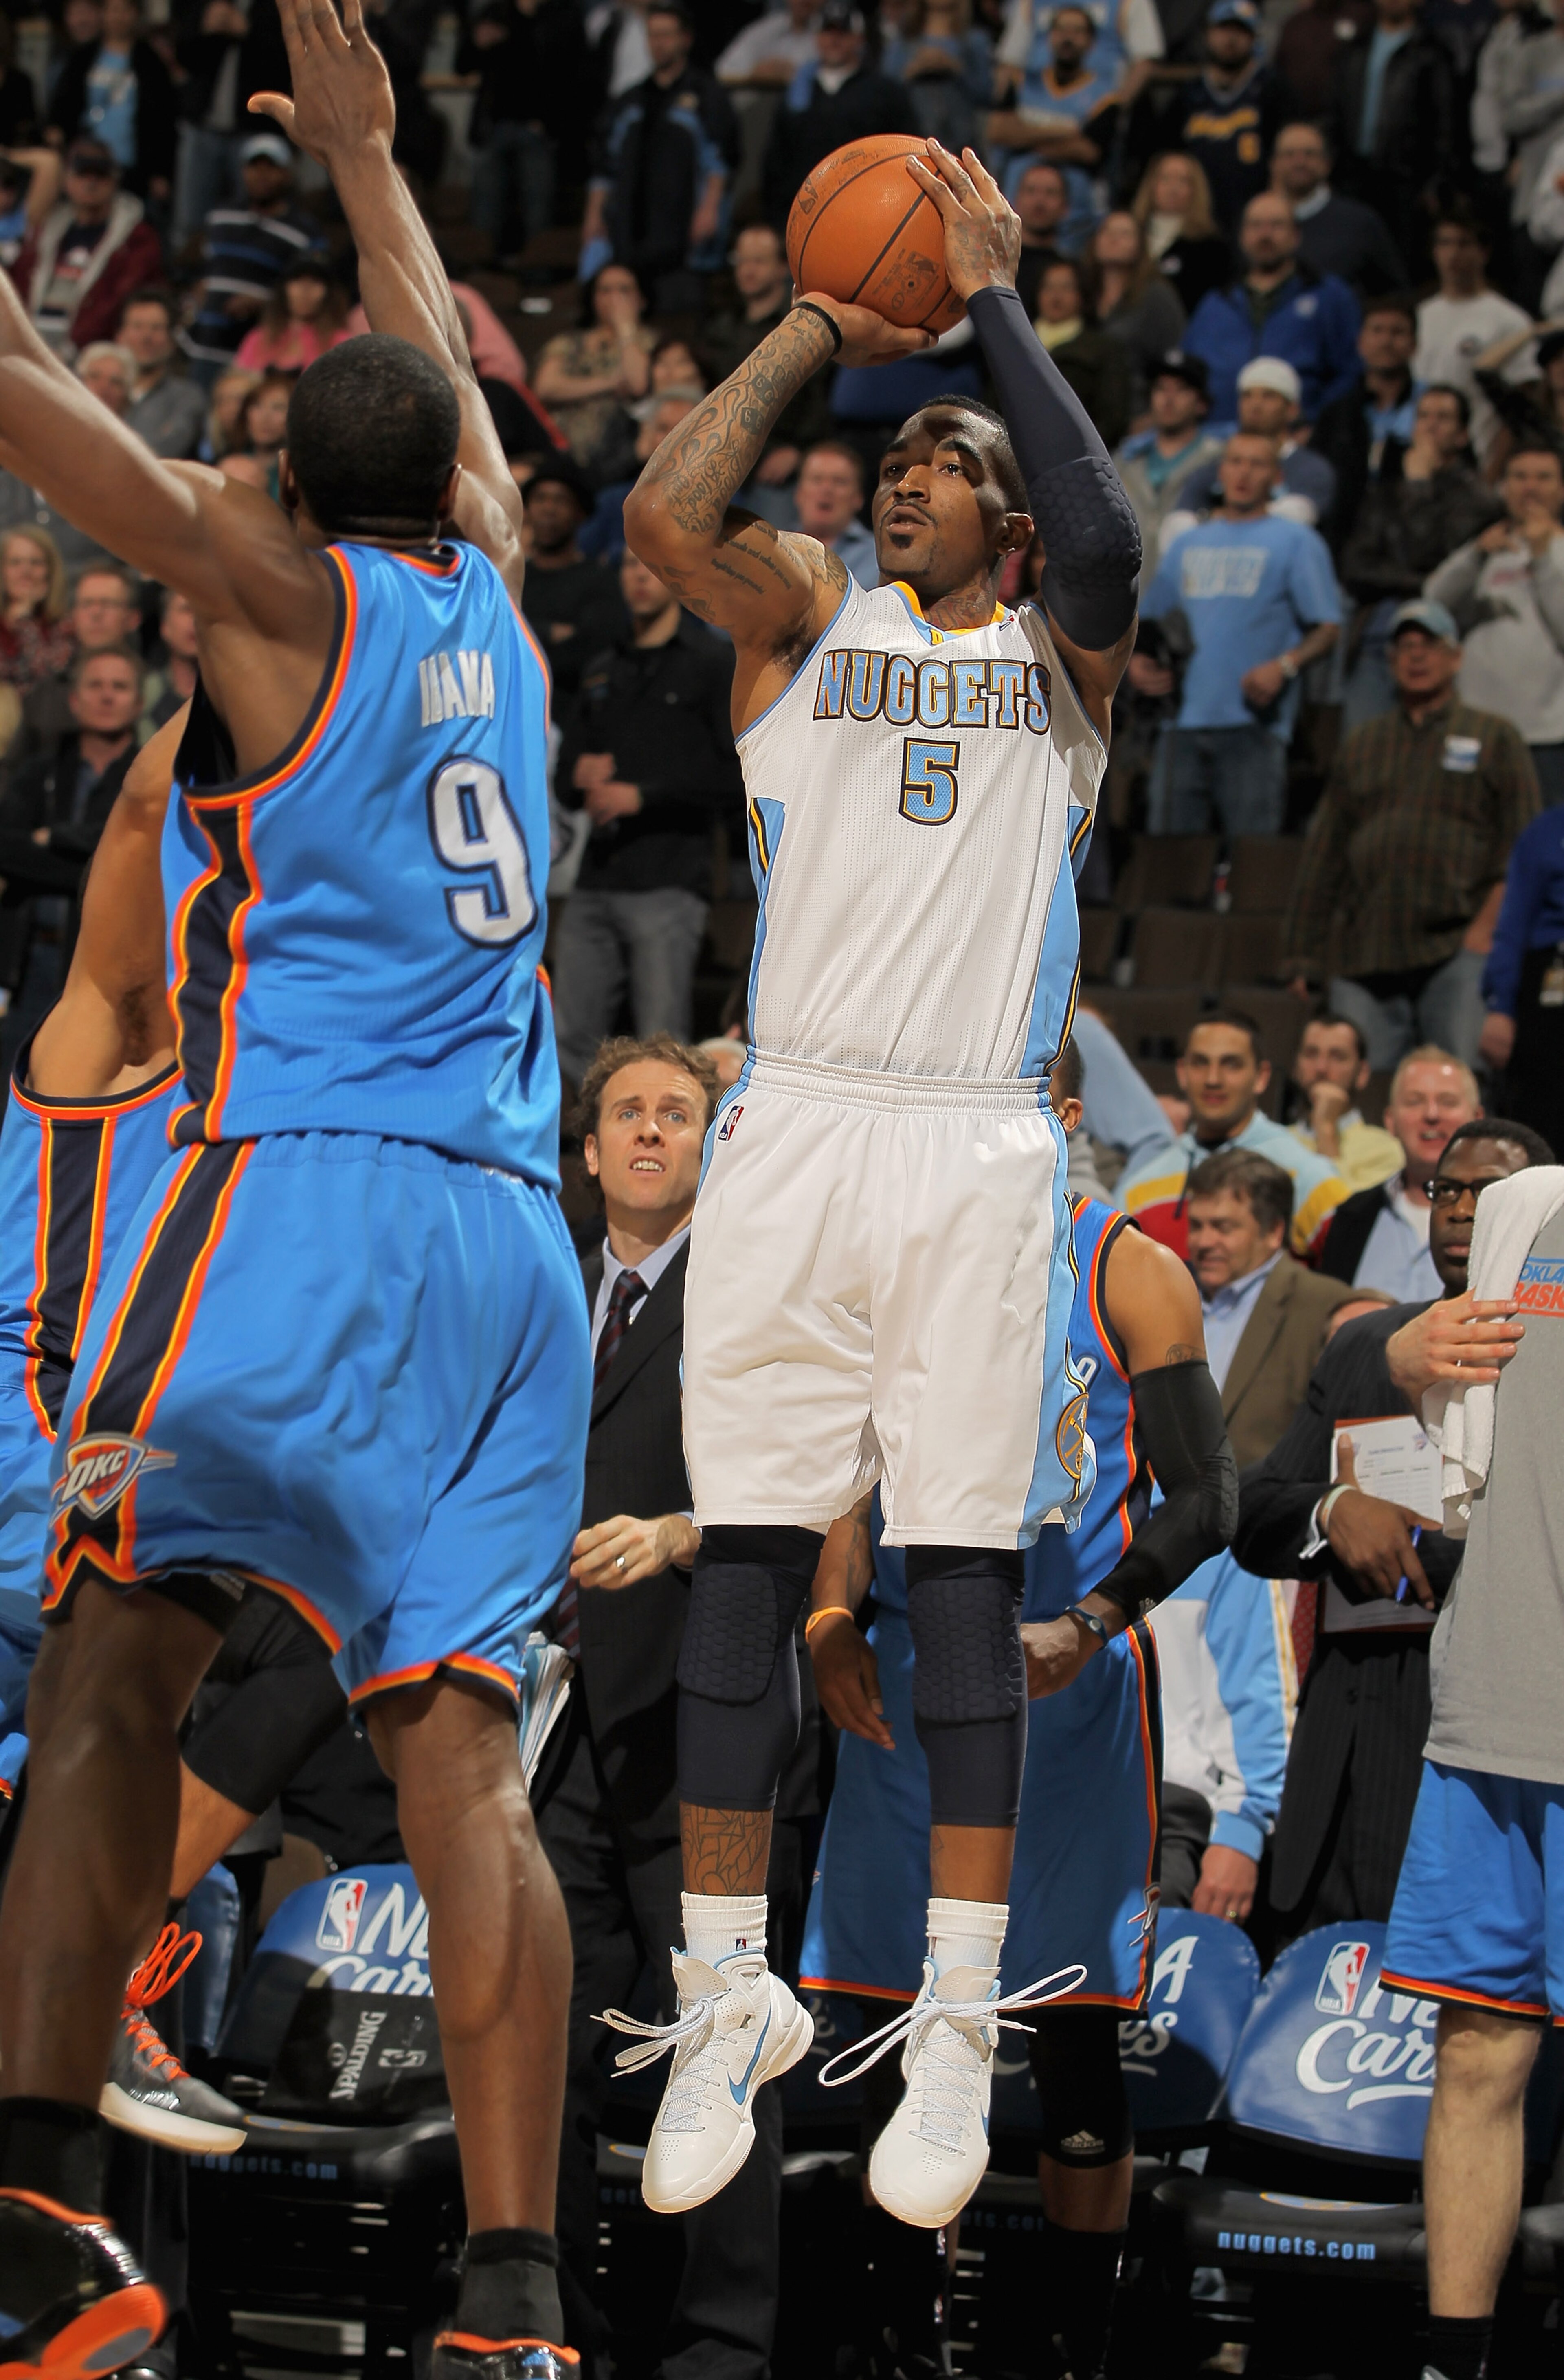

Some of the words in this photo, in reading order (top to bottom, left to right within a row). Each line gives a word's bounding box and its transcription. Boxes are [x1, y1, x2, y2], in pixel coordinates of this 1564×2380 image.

[813, 649, 1051, 736] NUGGETS
[898, 737, 961, 826] 5
[427, 754, 538, 949] 9
[61, 1449, 127, 1502] OKC
[329, 2011, 387, 2100] SPALDING
[1217, 2231, 1376, 2260] nuggets.com
